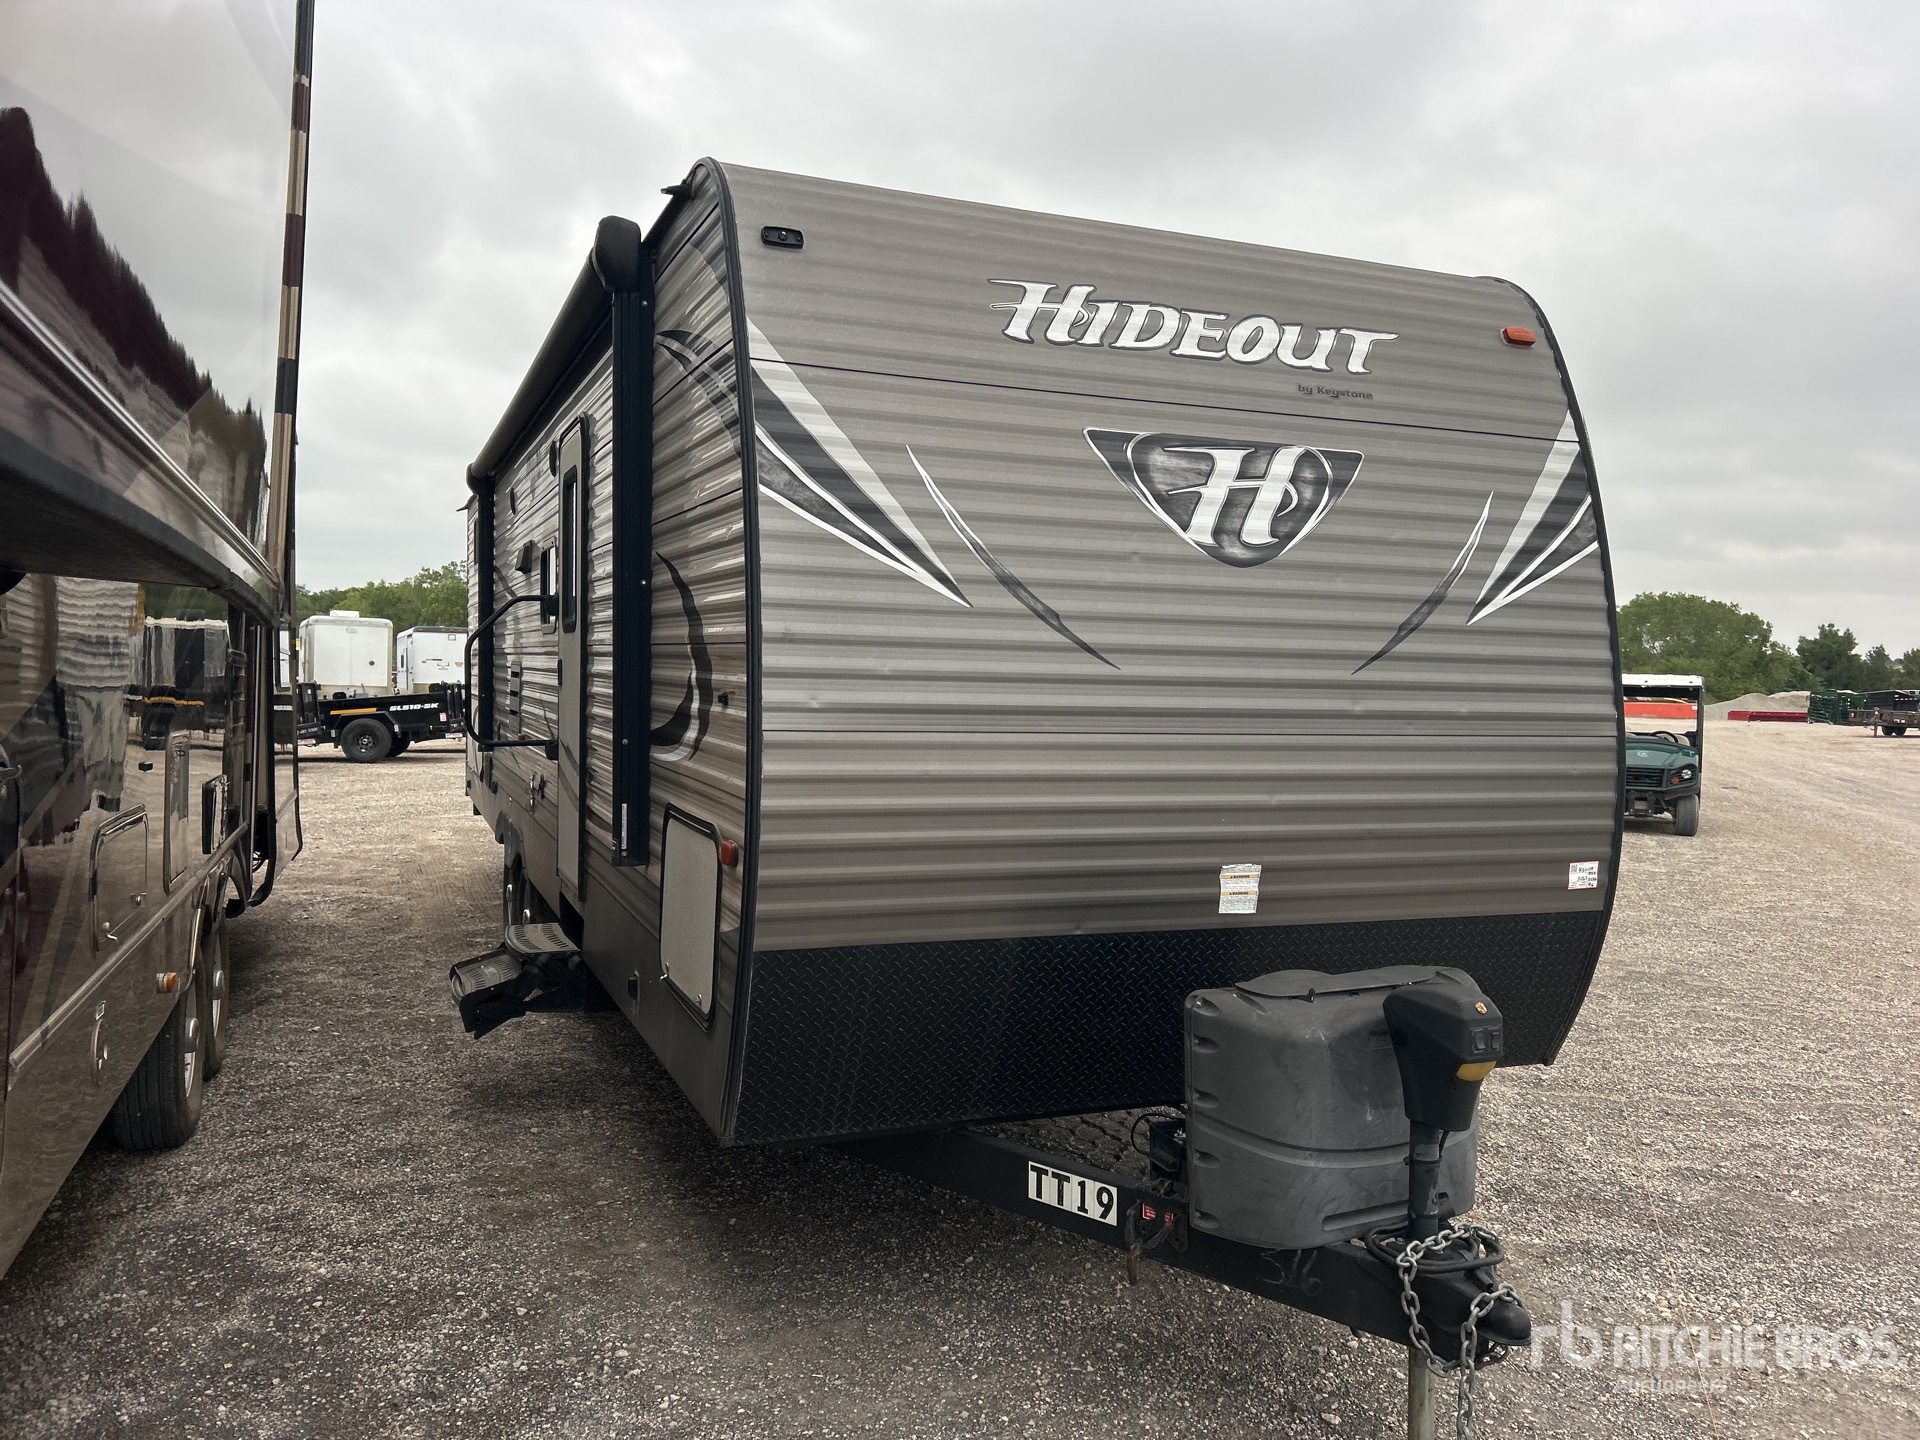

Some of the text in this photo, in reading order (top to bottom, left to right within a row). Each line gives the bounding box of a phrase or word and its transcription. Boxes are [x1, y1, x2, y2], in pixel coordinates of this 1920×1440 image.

[988, 279, 1399, 374] HIDEOUT
[1298, 384, 1374, 400] by Keystone
[1029, 1164, 1115, 1220] TT19
